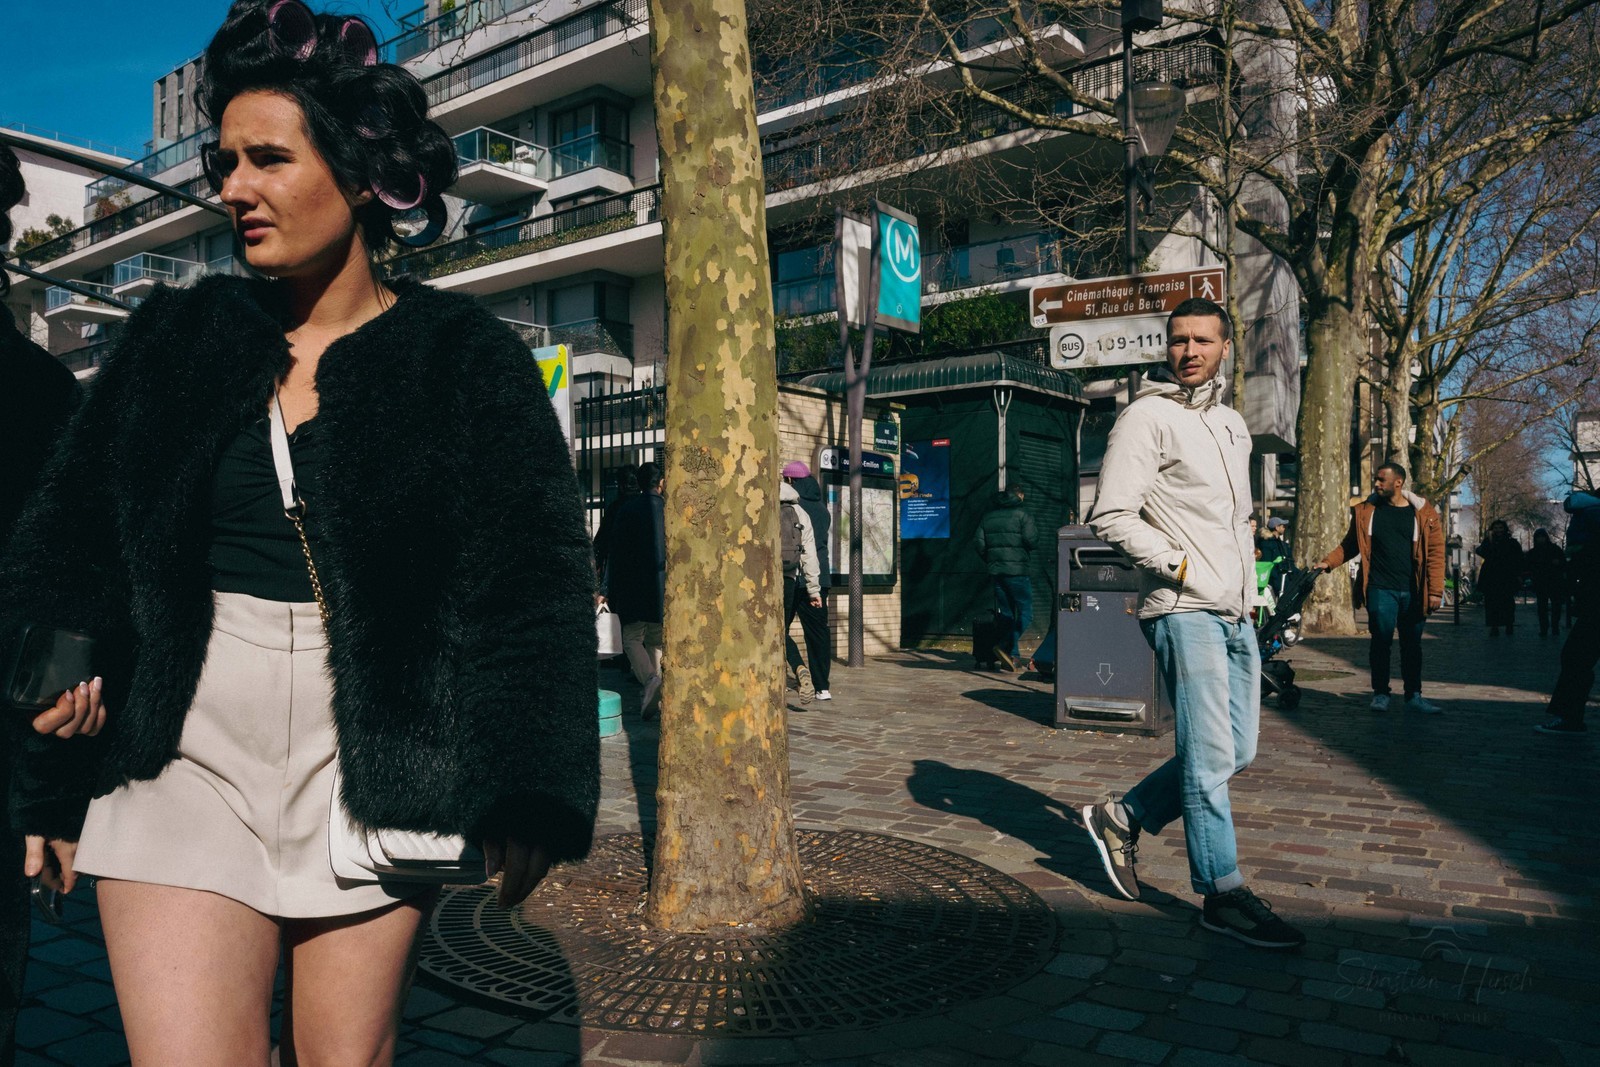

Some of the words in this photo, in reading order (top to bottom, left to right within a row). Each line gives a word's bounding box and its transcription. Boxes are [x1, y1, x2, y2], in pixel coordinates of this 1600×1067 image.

[895, 228, 915, 269] M
[1067, 286, 1133, 302] Cinémathèque
[1138, 279, 1185, 295] Française
[1085, 303, 1098, 316] 51,
[1101, 302, 1119, 314] Rue
[1123, 300, 1134, 311] de
[1138, 298, 1167, 311] Bercy
[1061, 342, 1080, 352] BUS
